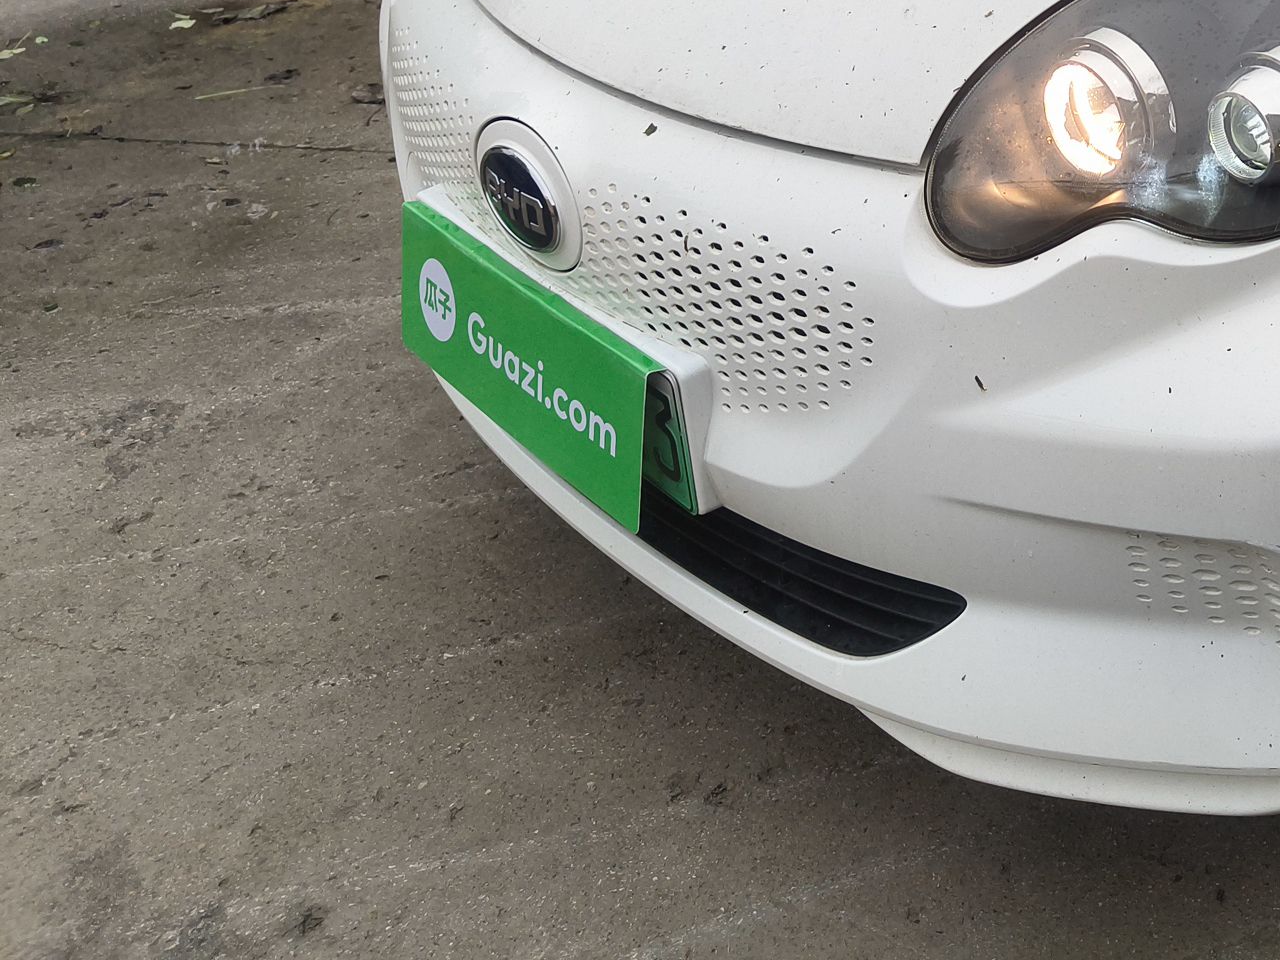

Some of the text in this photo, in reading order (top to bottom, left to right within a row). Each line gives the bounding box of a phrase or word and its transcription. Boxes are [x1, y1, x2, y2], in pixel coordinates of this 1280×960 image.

[485, 166, 547, 237] BYD
[423, 275, 453, 322] 瓜子
[466, 310, 618, 459] Guazi.com
